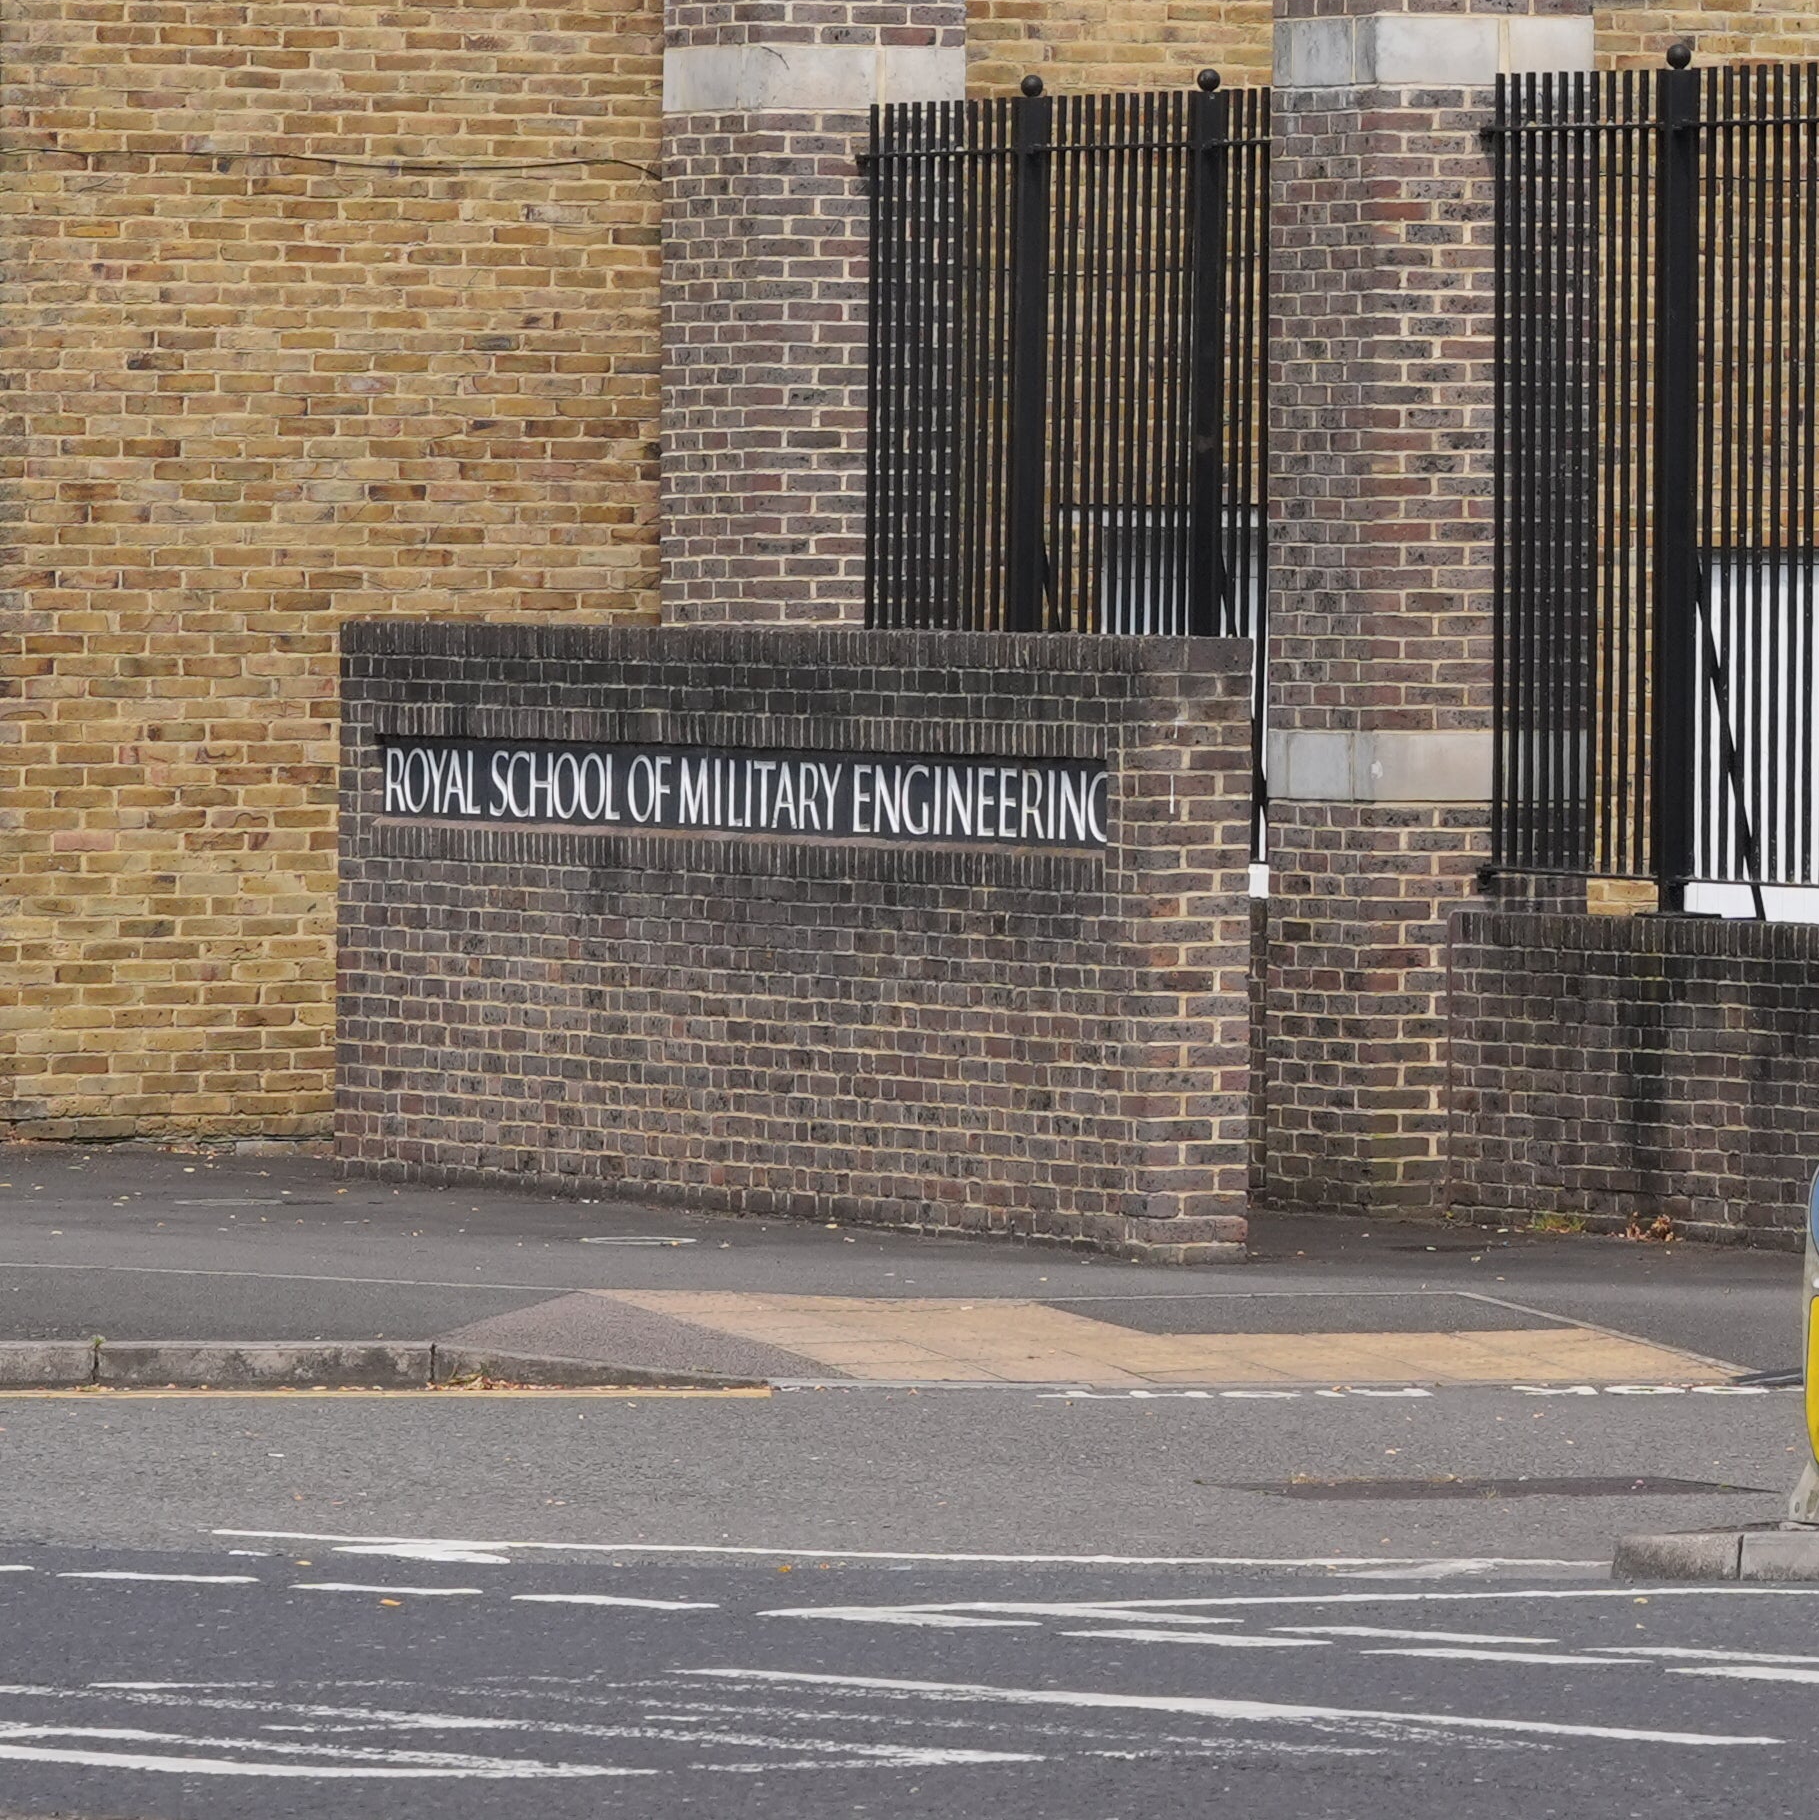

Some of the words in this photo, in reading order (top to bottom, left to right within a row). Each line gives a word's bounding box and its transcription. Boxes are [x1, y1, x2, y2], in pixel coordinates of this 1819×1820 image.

[385, 747, 482, 815] ROYAL
[489, 750, 621, 821] SCHOOL
[628, 754, 672, 824] OF
[678, 756, 843, 831] MILITARY
